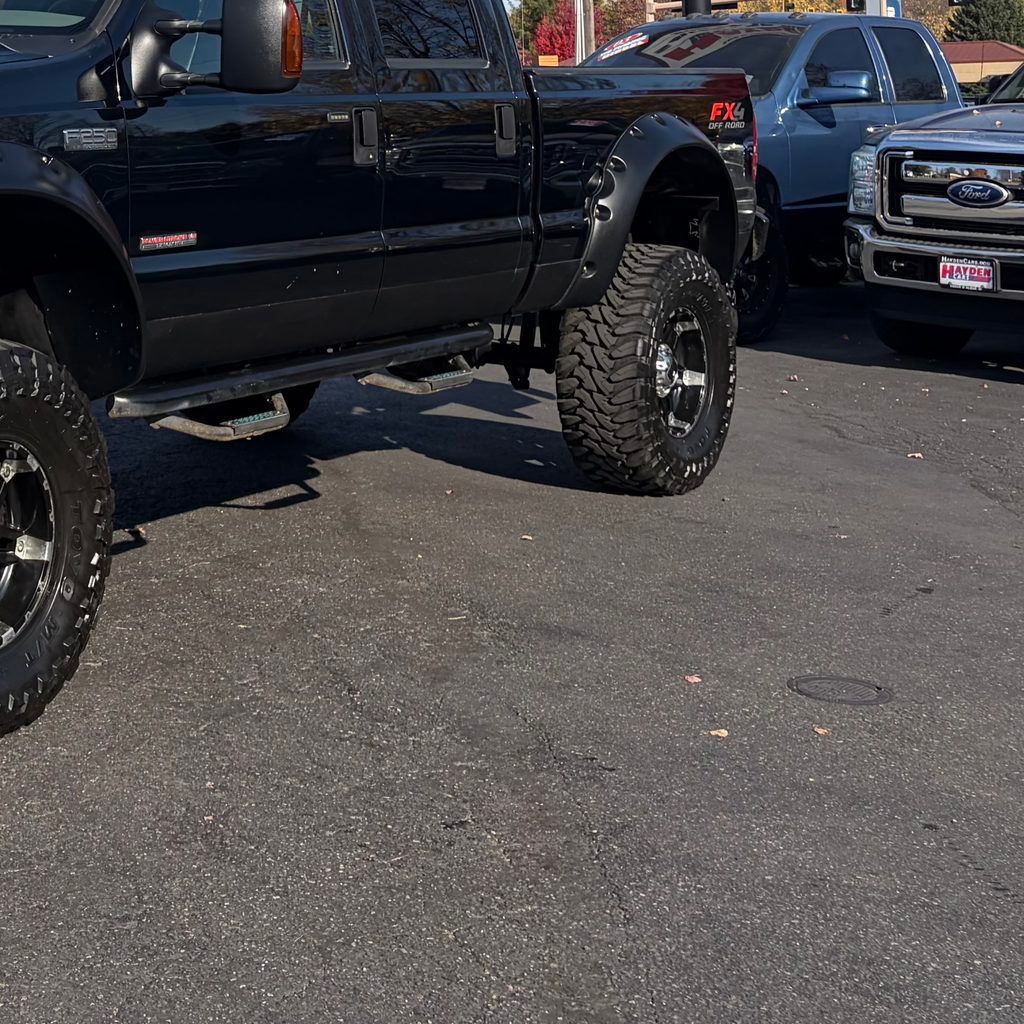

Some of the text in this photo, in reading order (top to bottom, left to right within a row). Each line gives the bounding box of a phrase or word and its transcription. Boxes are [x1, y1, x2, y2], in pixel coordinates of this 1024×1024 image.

[710, 102, 745, 121] FX4
[725, 121, 745, 129] ROAD
[959, 184, 991, 200] Ford
[941, 264, 991, 278] HAYDEN
